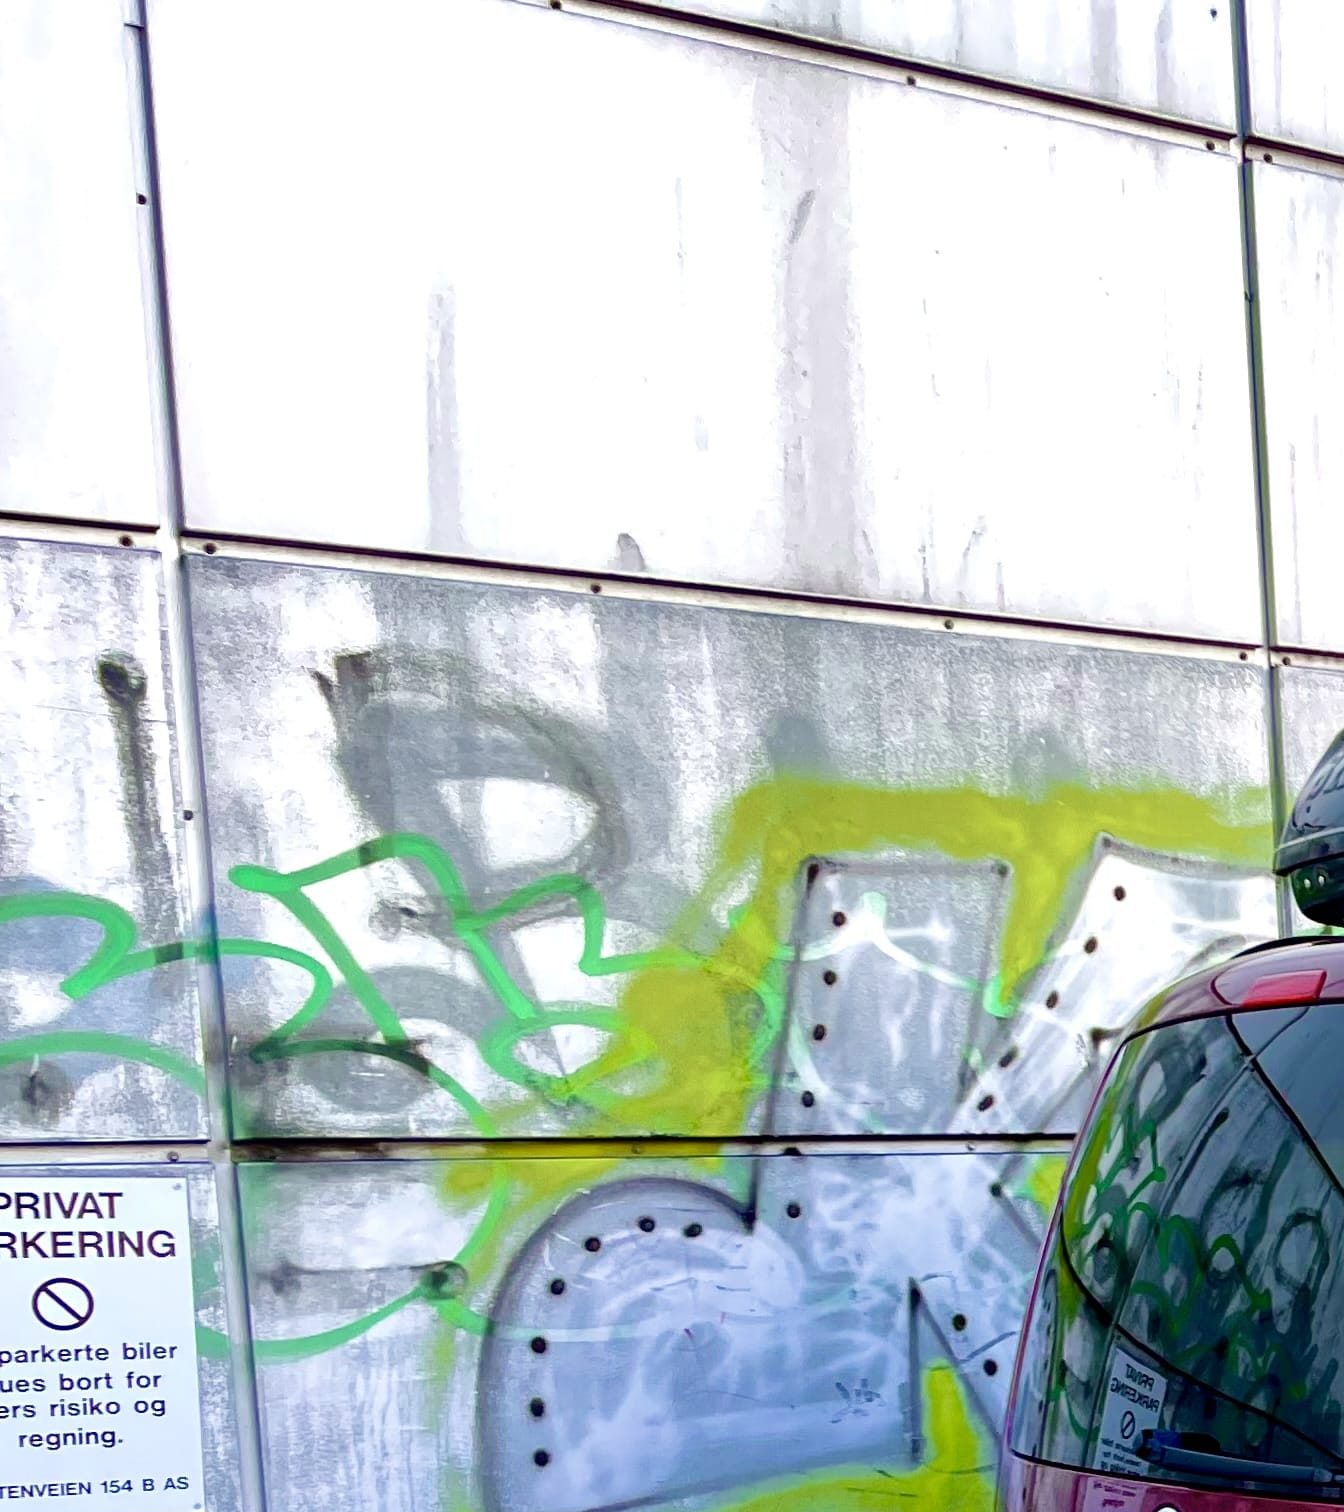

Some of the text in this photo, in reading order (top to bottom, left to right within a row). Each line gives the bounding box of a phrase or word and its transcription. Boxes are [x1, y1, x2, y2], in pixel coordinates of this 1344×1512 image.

[0, 1230, 176, 1258] RKERING
[0, 1342, 178, 1368] parkerte biler
[0, 1371, 162, 1393] ues bort for
[50, 1397, 121, 1417] risiko
[134, 1399, 166, 1417] og
[18, 1427, 124, 1451] regning.
[100, 1479, 133, 1494] 154
[142, 1478, 155, 1492] B
[163, 1476, 190, 1491] AS
